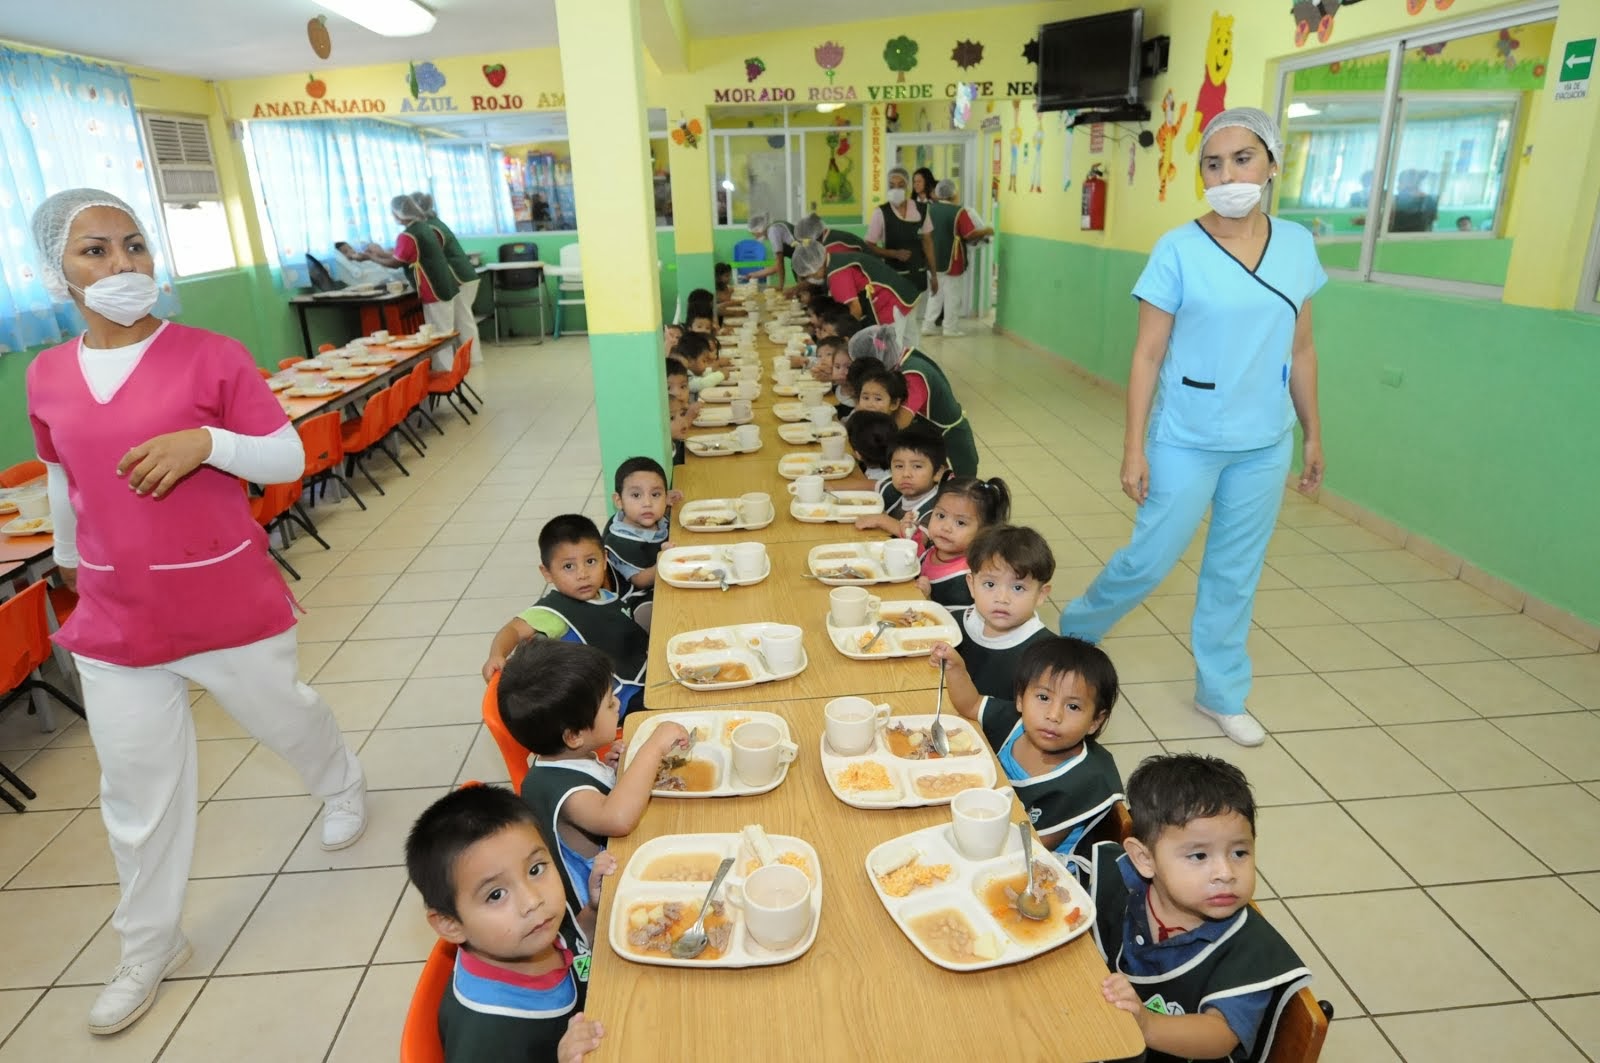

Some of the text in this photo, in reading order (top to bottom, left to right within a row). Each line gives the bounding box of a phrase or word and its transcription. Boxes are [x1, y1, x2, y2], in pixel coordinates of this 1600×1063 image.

[713, 88, 795, 103] MORADO
[808, 85, 858, 101] ROSA
[868, 83, 933, 100] VERDE
[945, 81, 994, 98] CFE
[252, 98, 386, 118] ANARANJADO
[400, 95, 458, 113] AZUL
[471, 94, 523, 111] ROJO
